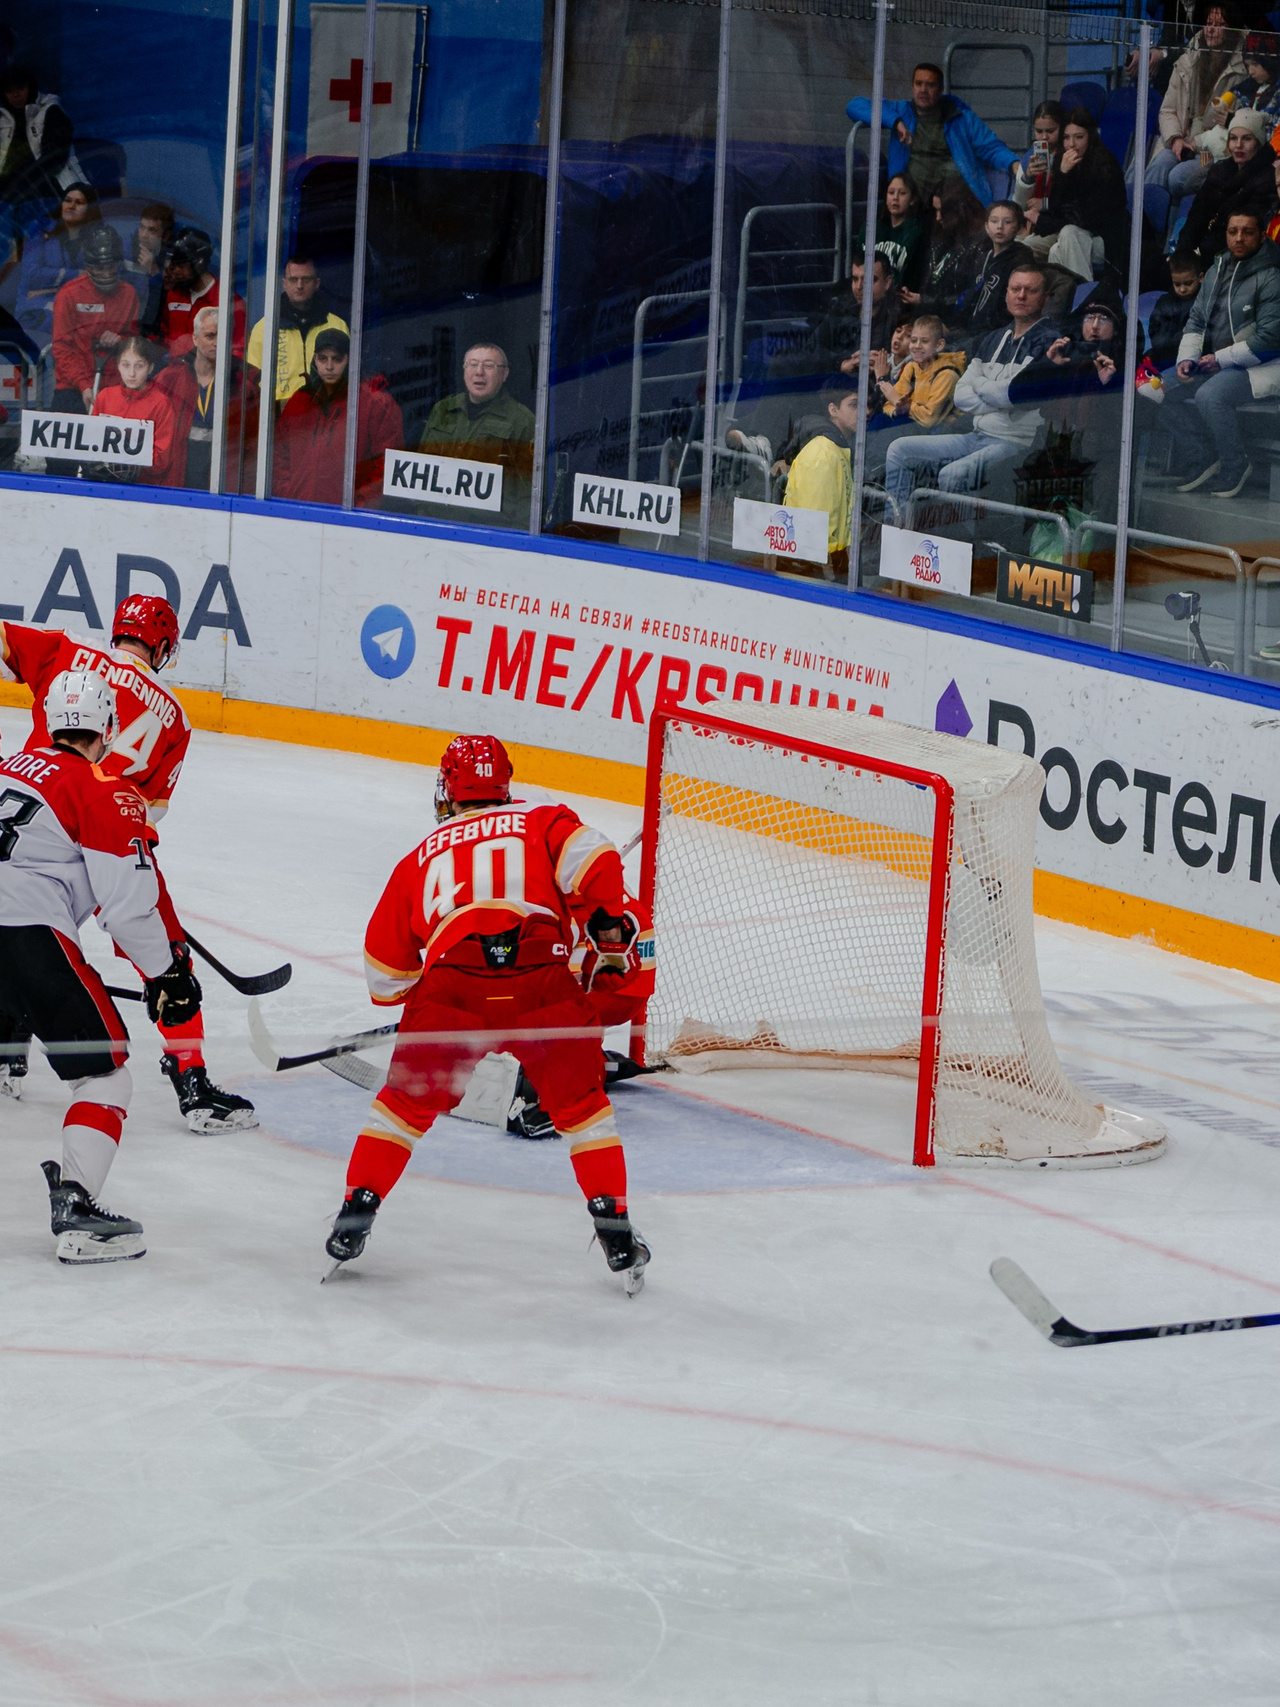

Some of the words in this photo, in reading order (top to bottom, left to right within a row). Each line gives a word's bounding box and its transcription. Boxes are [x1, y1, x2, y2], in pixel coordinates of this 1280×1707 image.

[30, 419, 145, 455] KHL.RU
[391, 459, 495, 500] KHL.RU
[579, 483, 674, 524] KHL.RU
[764, 525, 786, 539] АВТО
[769, 538, 797, 553] РАДИО
[910, 554, 931, 568] АВТО
[915, 567, 942, 584] РАДИО
[439, 583, 467, 602] МЫ
[476, 589, 540, 615] ВСЕГДА
[550, 601, 570, 620] НА
[580, 606, 633, 631] СВЯЗИ
[641, 617, 777, 661] #REDSTARHOCKEY
[783, 648, 891, 690] #UNITEDWEWIN
[70, 648, 177, 729] CLENDENING
[64, 711, 80, 727] 13
[475, 763, 493, 778] 40
[987, 699, 1280, 888] Ростел
[418, 813, 527, 867] LEFEBVRE
[422, 836, 525, 926] 40
